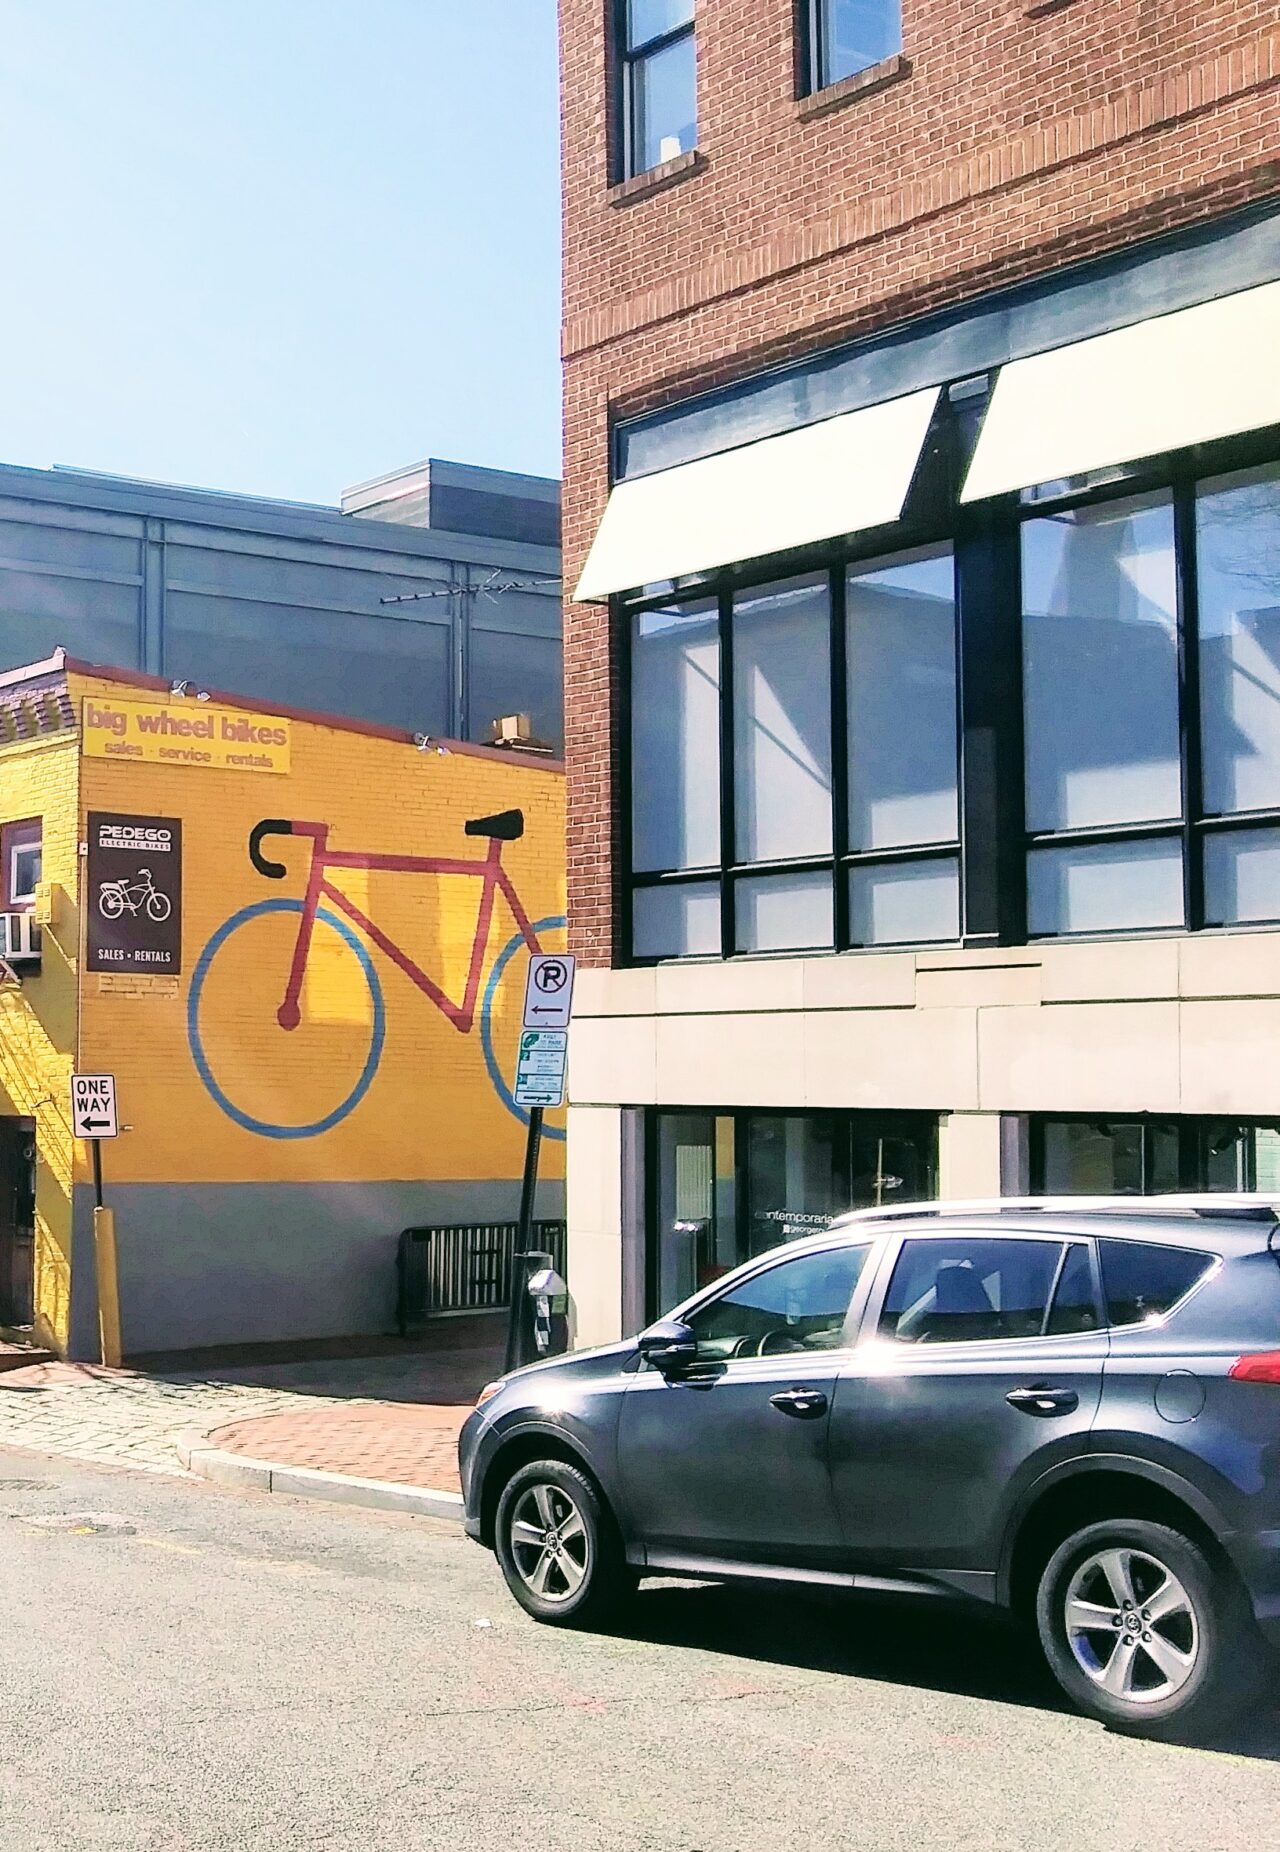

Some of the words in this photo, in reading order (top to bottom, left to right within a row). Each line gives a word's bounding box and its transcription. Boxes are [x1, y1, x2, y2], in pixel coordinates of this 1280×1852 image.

[87, 703, 127, 736] big
[136, 710, 214, 739] wheel
[221, 716, 287, 746] bikes
[105, 740, 143, 756] sales
[159, 747, 212, 762] service
[226, 753, 273, 768] rentals
[100, 825, 171, 841] PEDEGO
[101, 839, 141, 848] ELECTRIC
[98, 949, 124, 960] SALES
[134, 950, 171, 962] RENTALS
[77, 1080, 109, 1094] ONE
[77, 1098, 110, 1112] WAY
